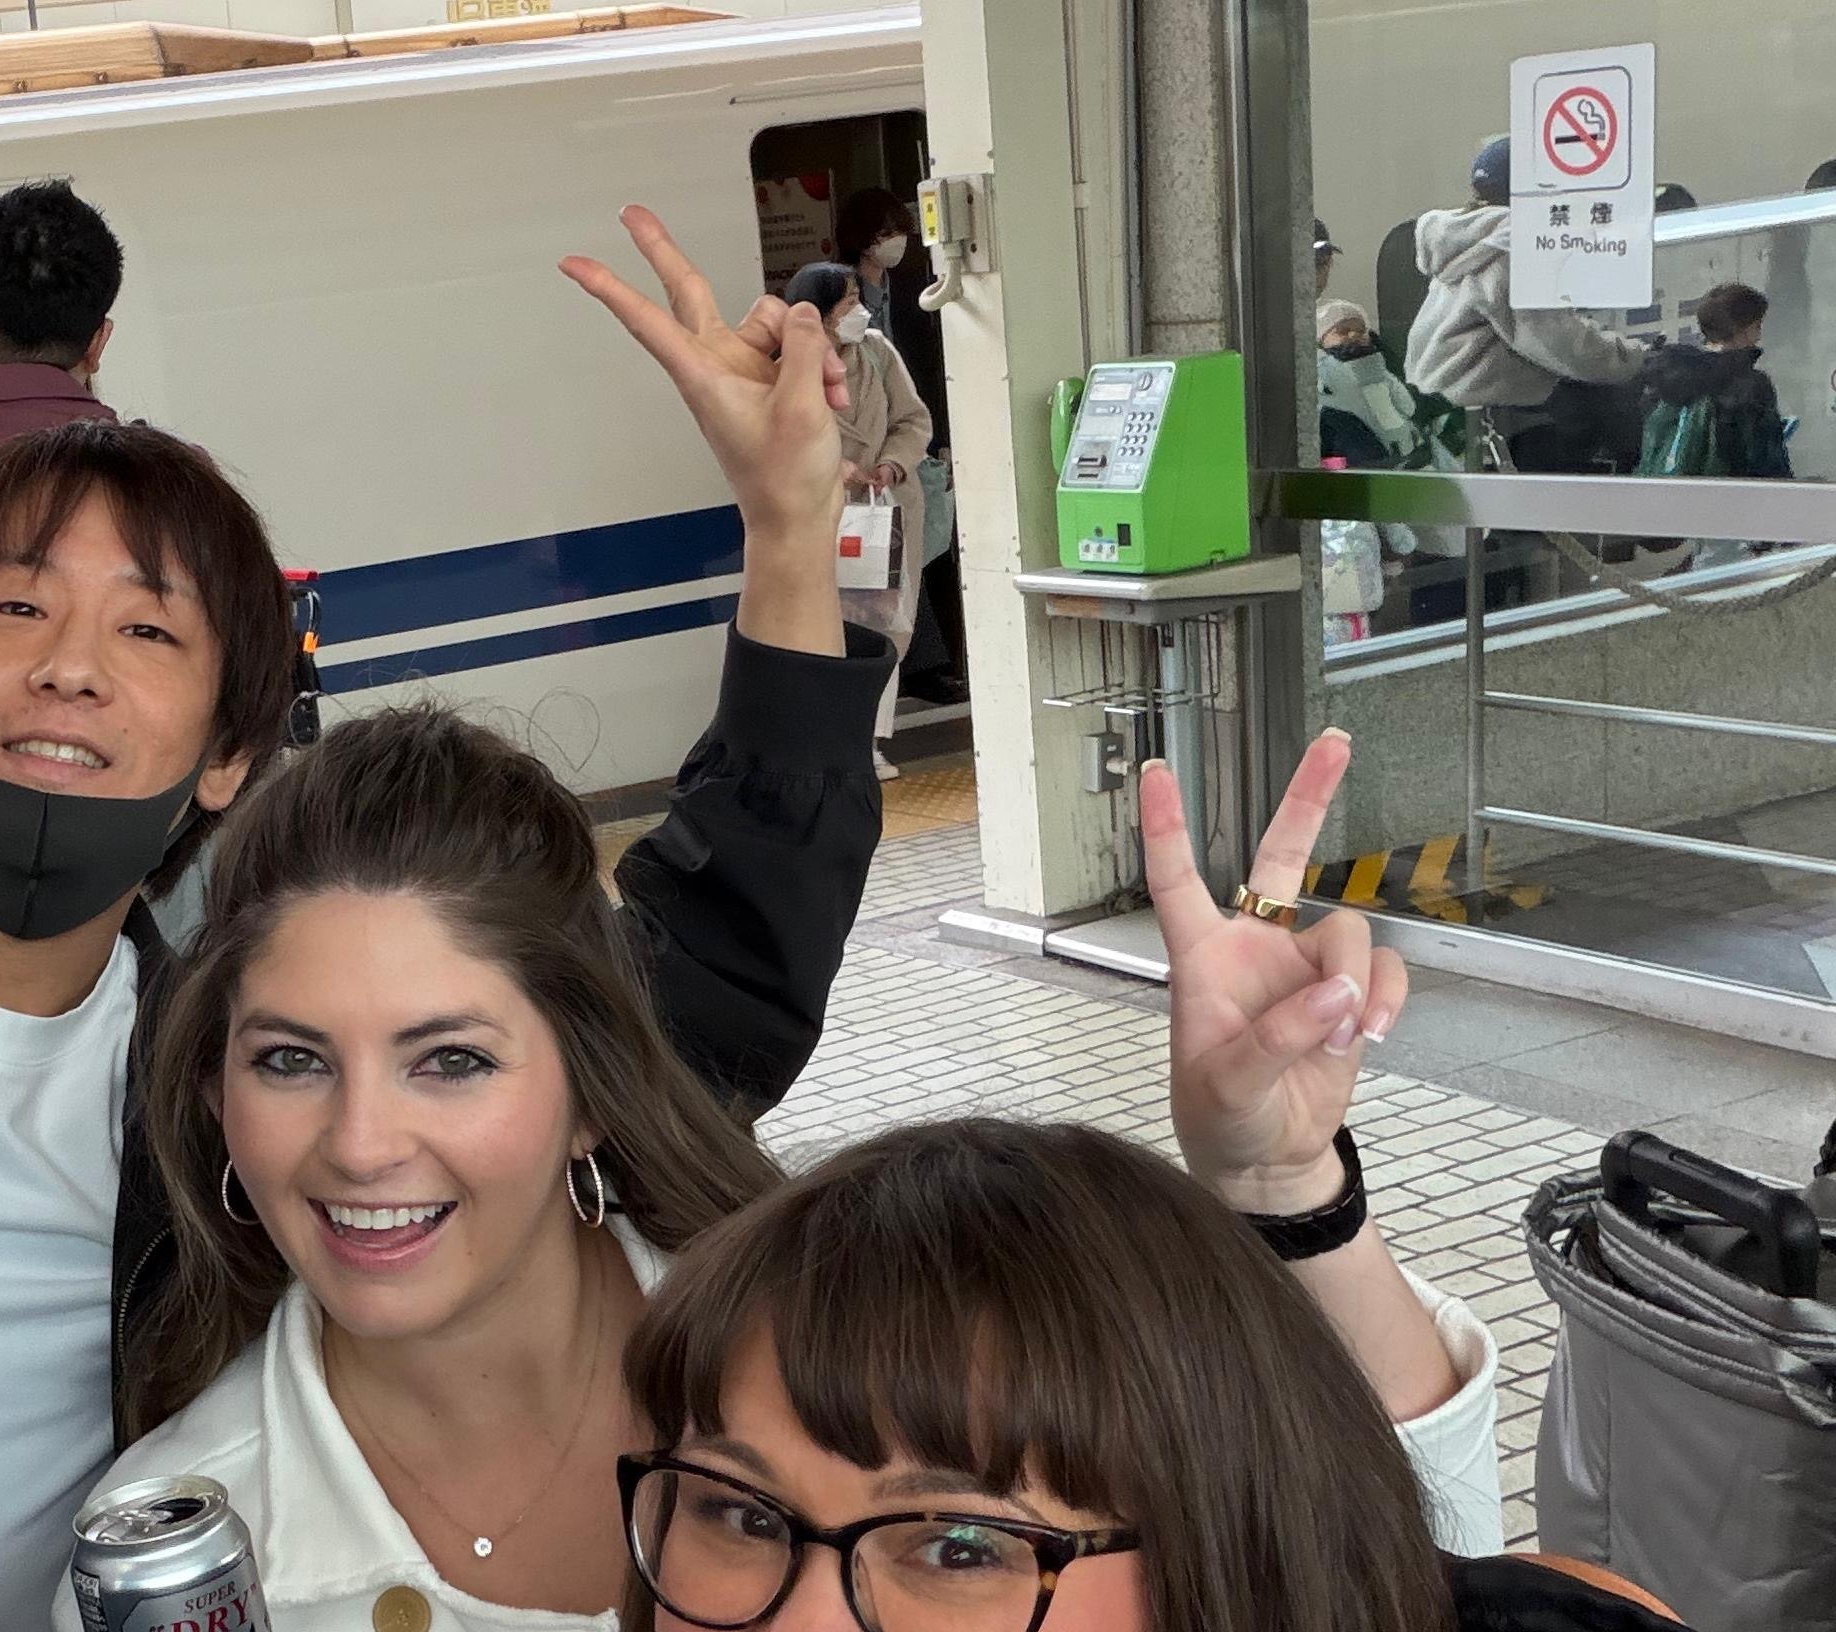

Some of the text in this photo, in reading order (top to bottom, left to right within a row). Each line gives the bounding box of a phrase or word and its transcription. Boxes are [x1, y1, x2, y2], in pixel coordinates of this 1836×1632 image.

[1549, 201, 1614, 227] 禁煙
[1536, 233, 1627, 256] No Smoking
[184, 1581, 236, 1614] SUPER
